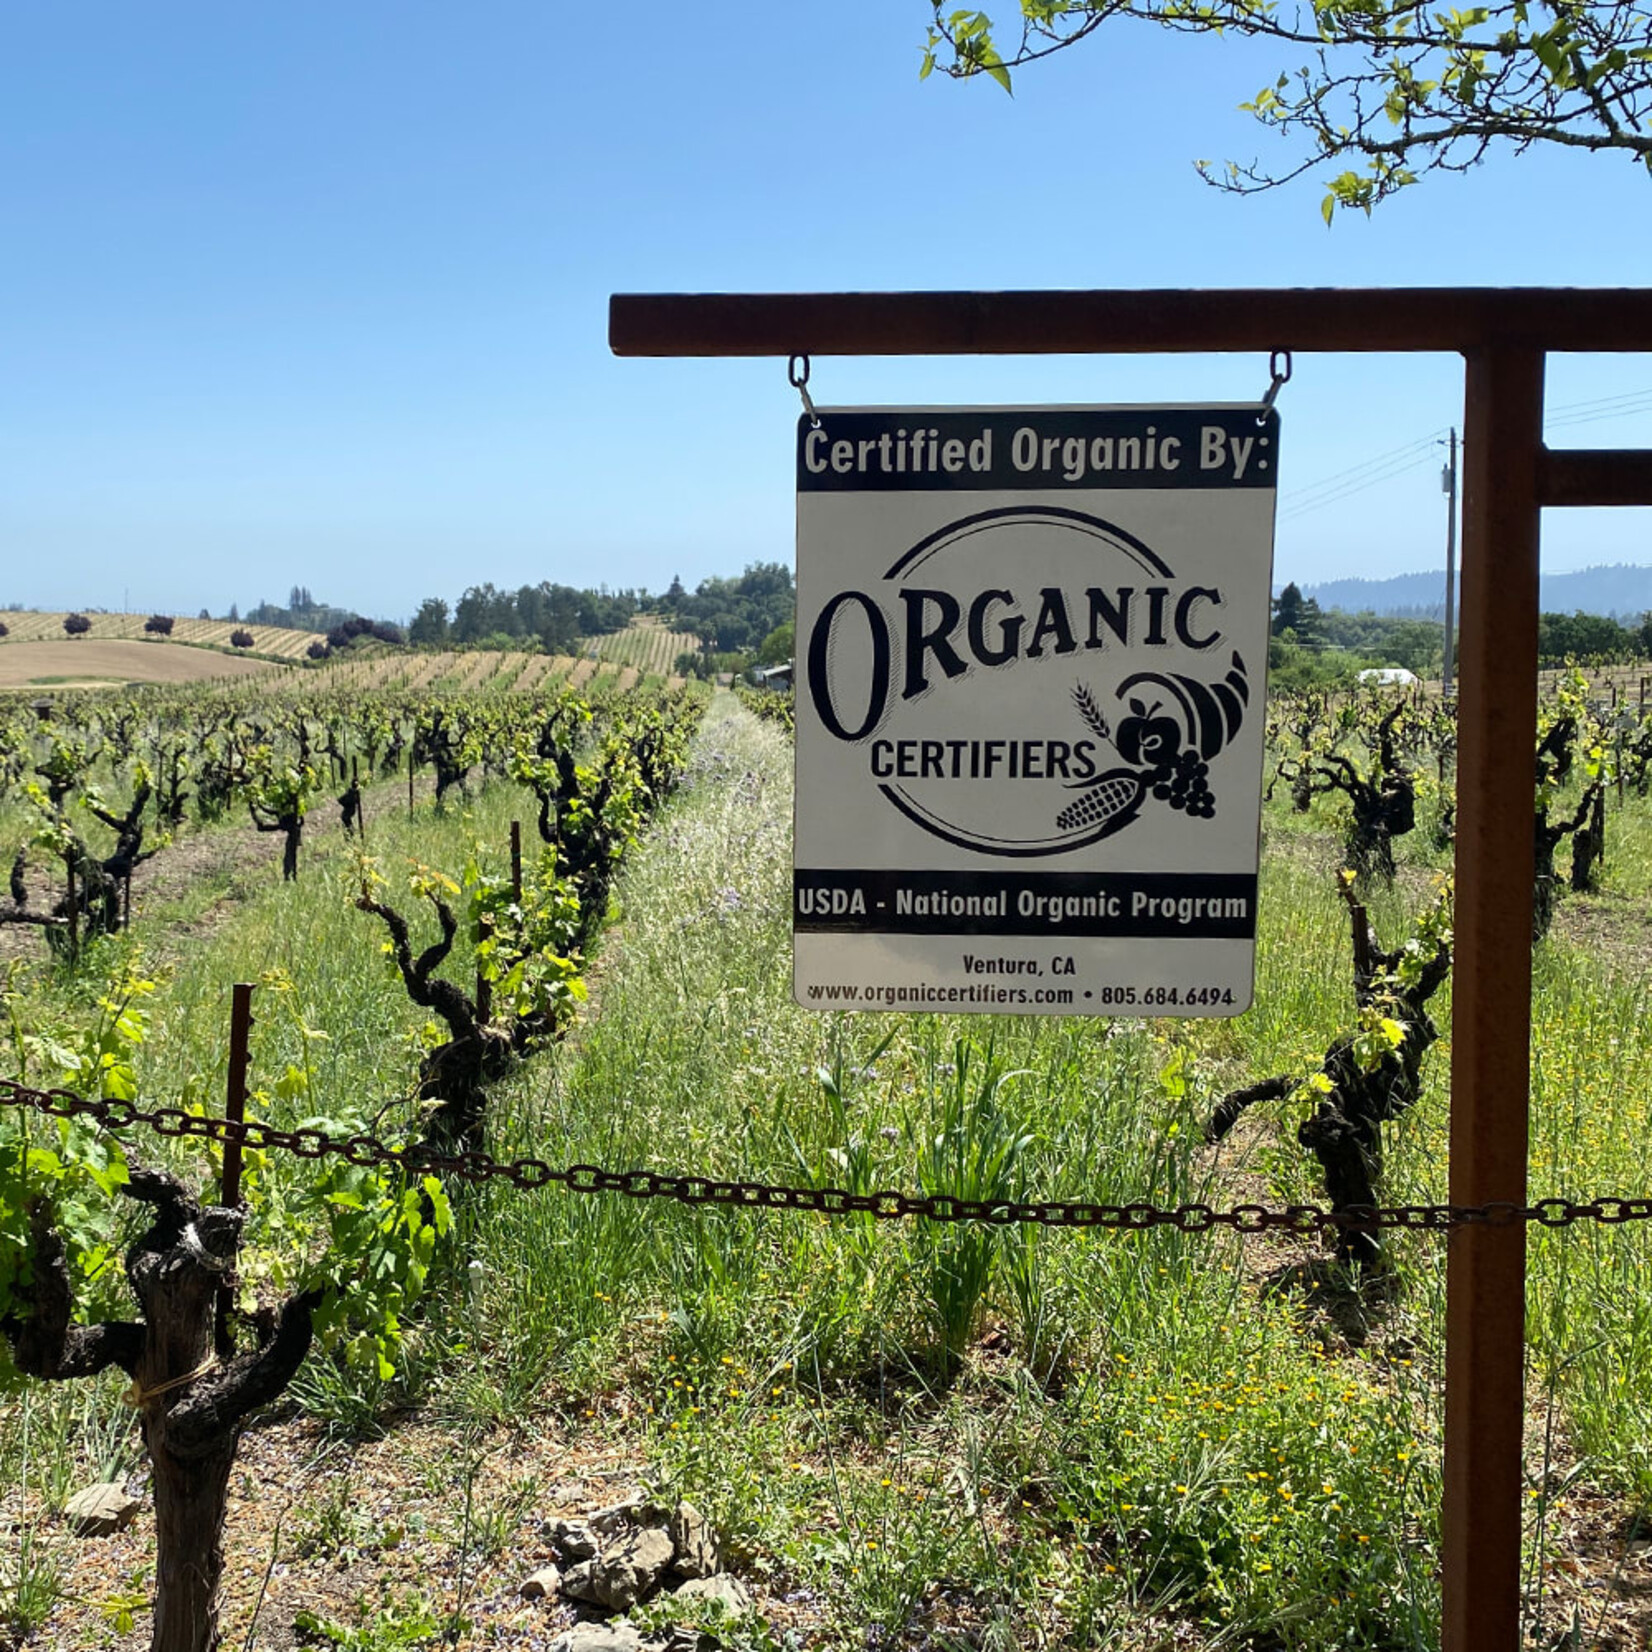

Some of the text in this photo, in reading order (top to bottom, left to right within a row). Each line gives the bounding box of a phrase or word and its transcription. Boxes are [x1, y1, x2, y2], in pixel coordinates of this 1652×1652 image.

[805, 424, 1270, 481] Certified Organic By:
[807, 586, 1225, 742] ORGANIC
[871, 739, 1096, 780] CERTIFIERS
[798, 888, 866, 916] USDA
[896, 889, 1007, 918] National
[1017, 890, 1121, 924] Organic
[1132, 891, 1248, 924] Program
[963, 954, 1076, 977] Ventura, CA
[808, 983, 1233, 1006] www.organiccertifiers.com 805.684.6494
